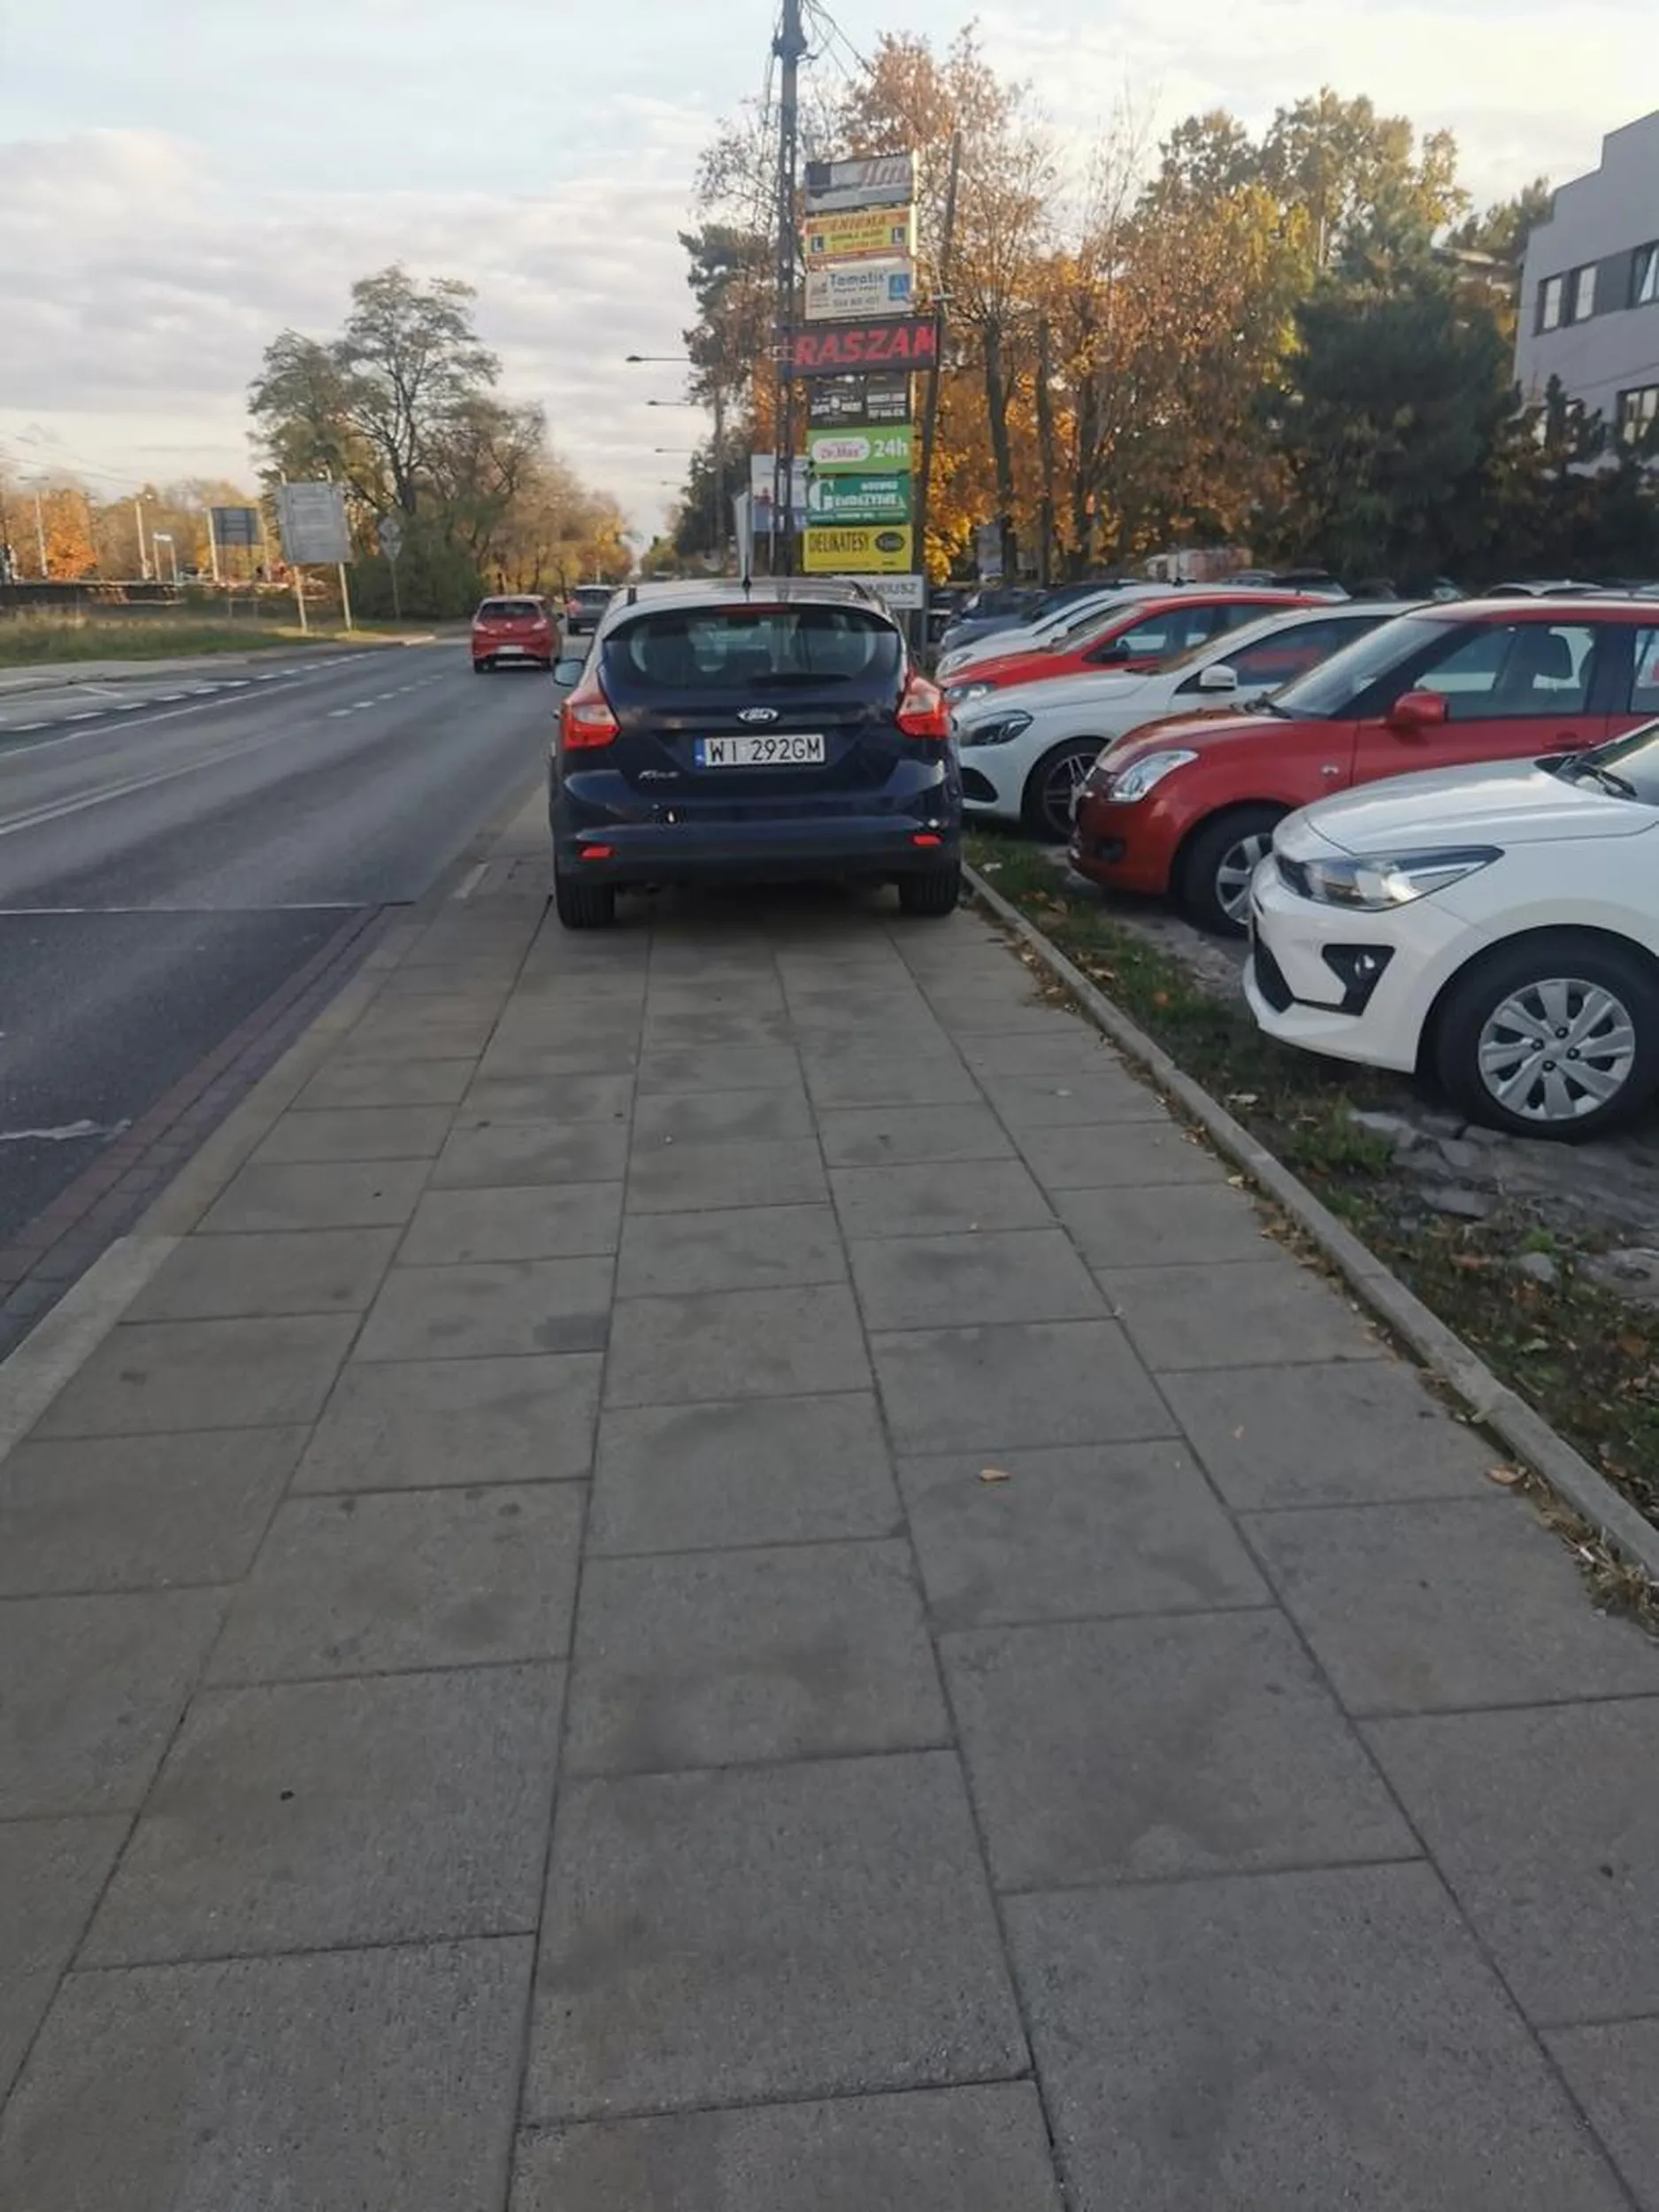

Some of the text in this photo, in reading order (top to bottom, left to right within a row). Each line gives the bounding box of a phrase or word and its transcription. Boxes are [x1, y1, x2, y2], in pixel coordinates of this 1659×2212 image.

[873, 438, 909, 458] 24h
[710, 738, 821, 763] WI 292GM
